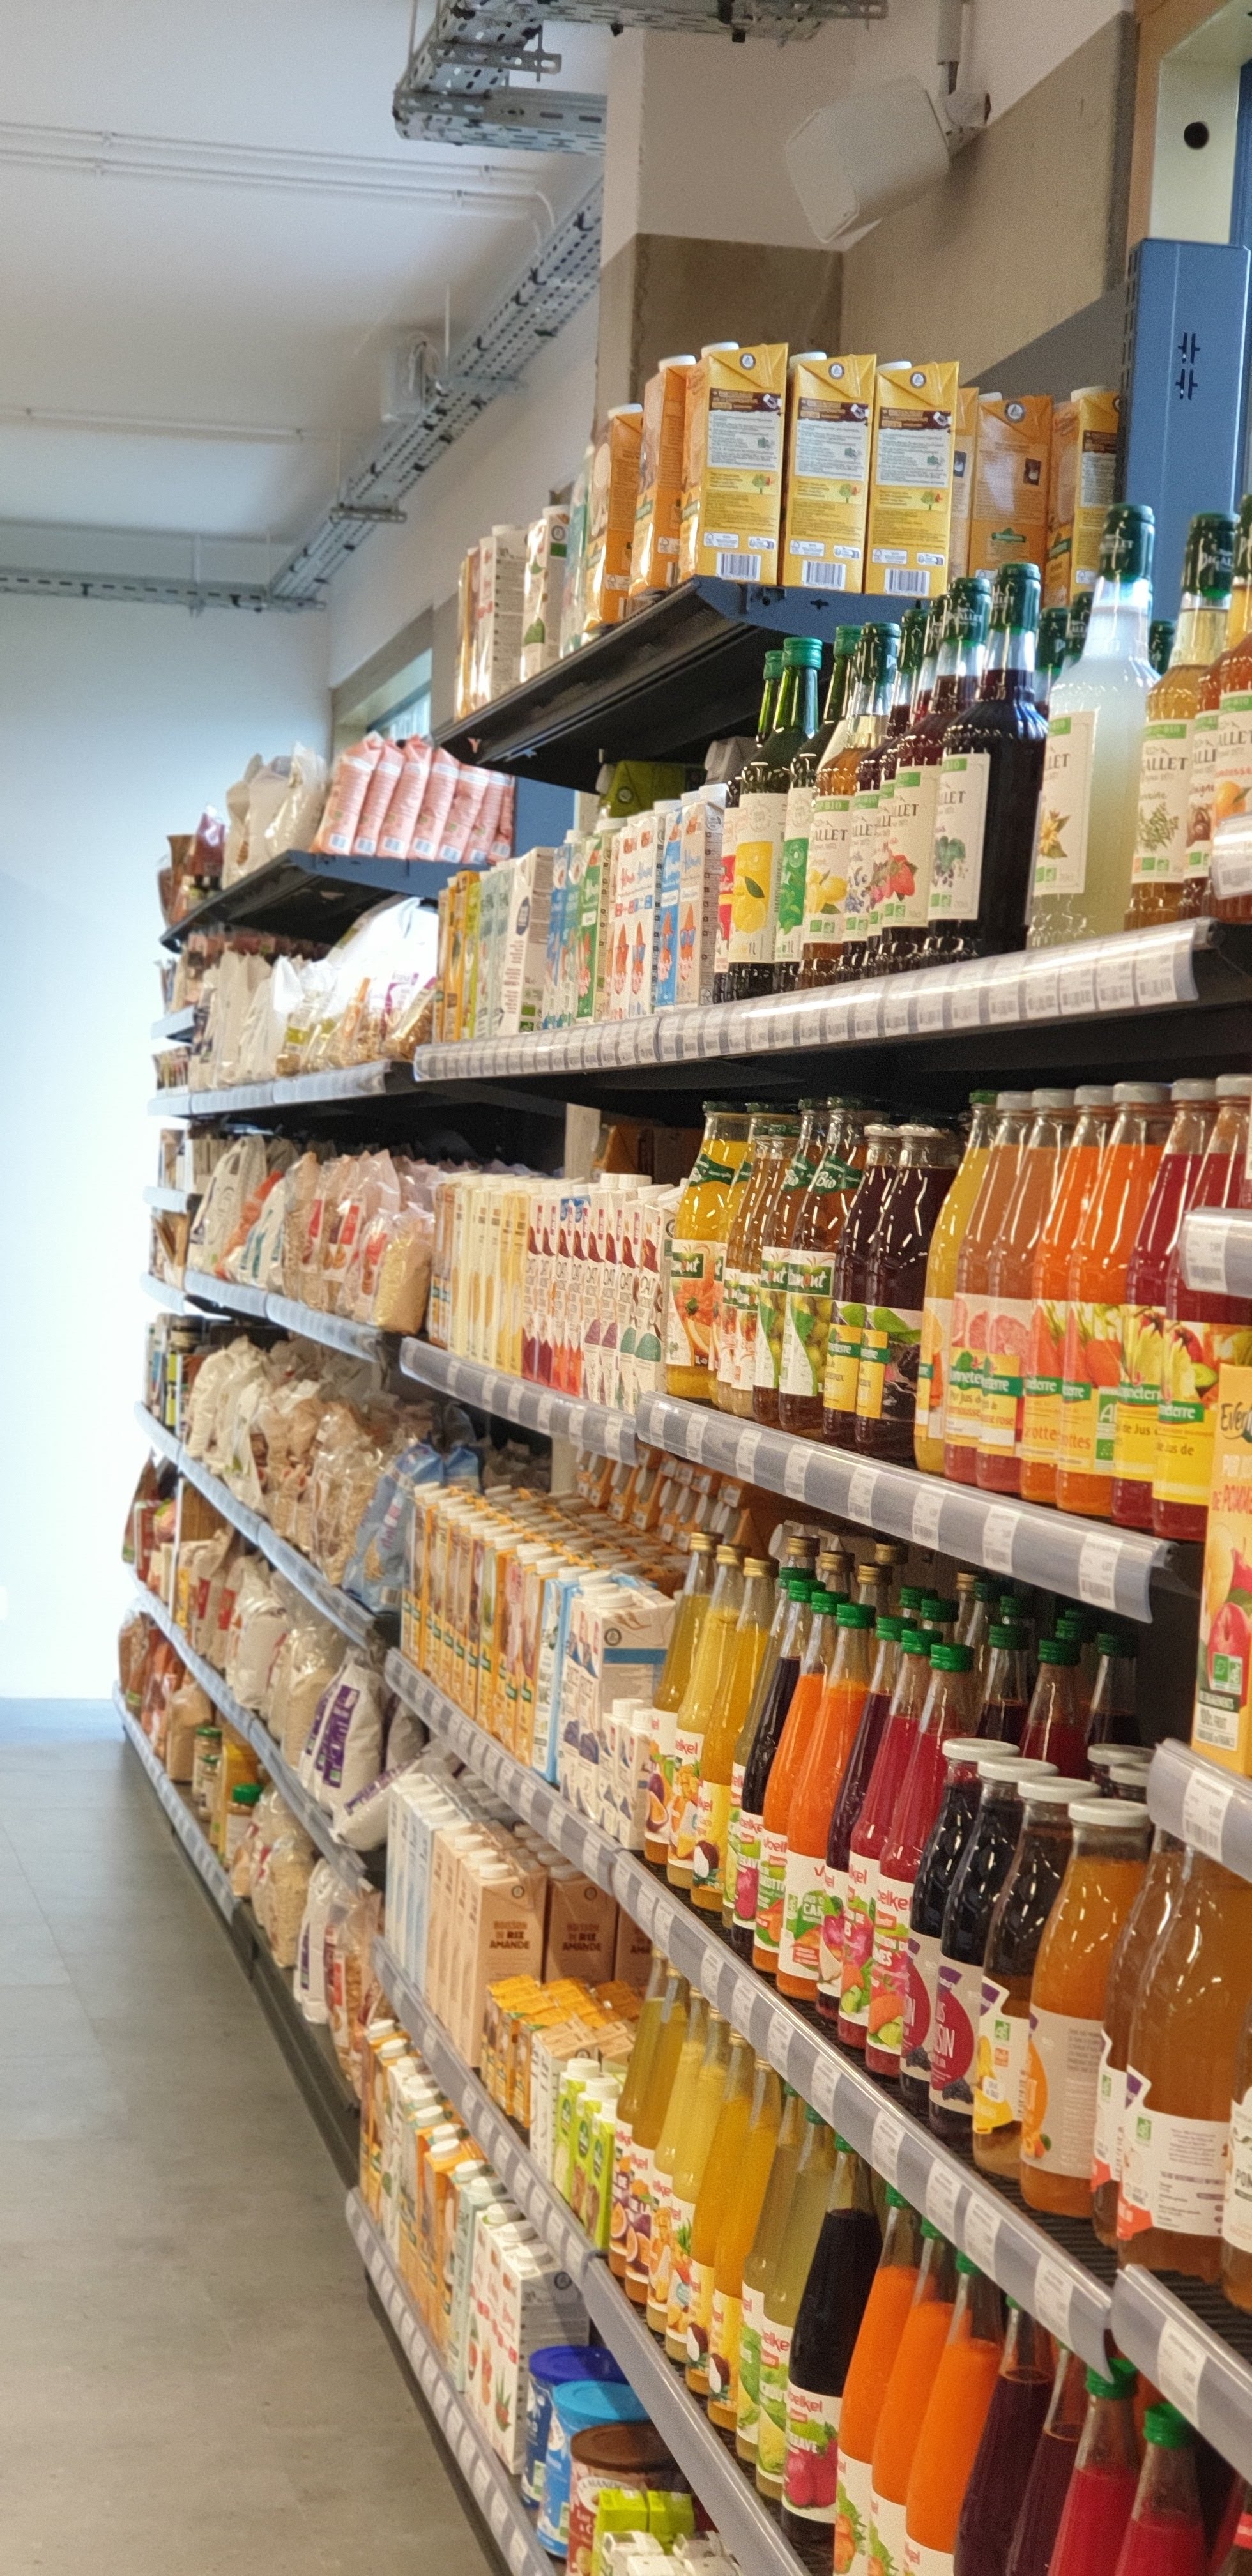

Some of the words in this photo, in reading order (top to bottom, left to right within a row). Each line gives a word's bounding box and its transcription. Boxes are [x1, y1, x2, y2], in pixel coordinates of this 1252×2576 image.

[816, 1171, 836, 1188] Bio
[1180, 1444, 1195, 1456] de
[489, 1940, 530, 1949] AMANDE
[563, 1942, 602, 1951] AMANDE
